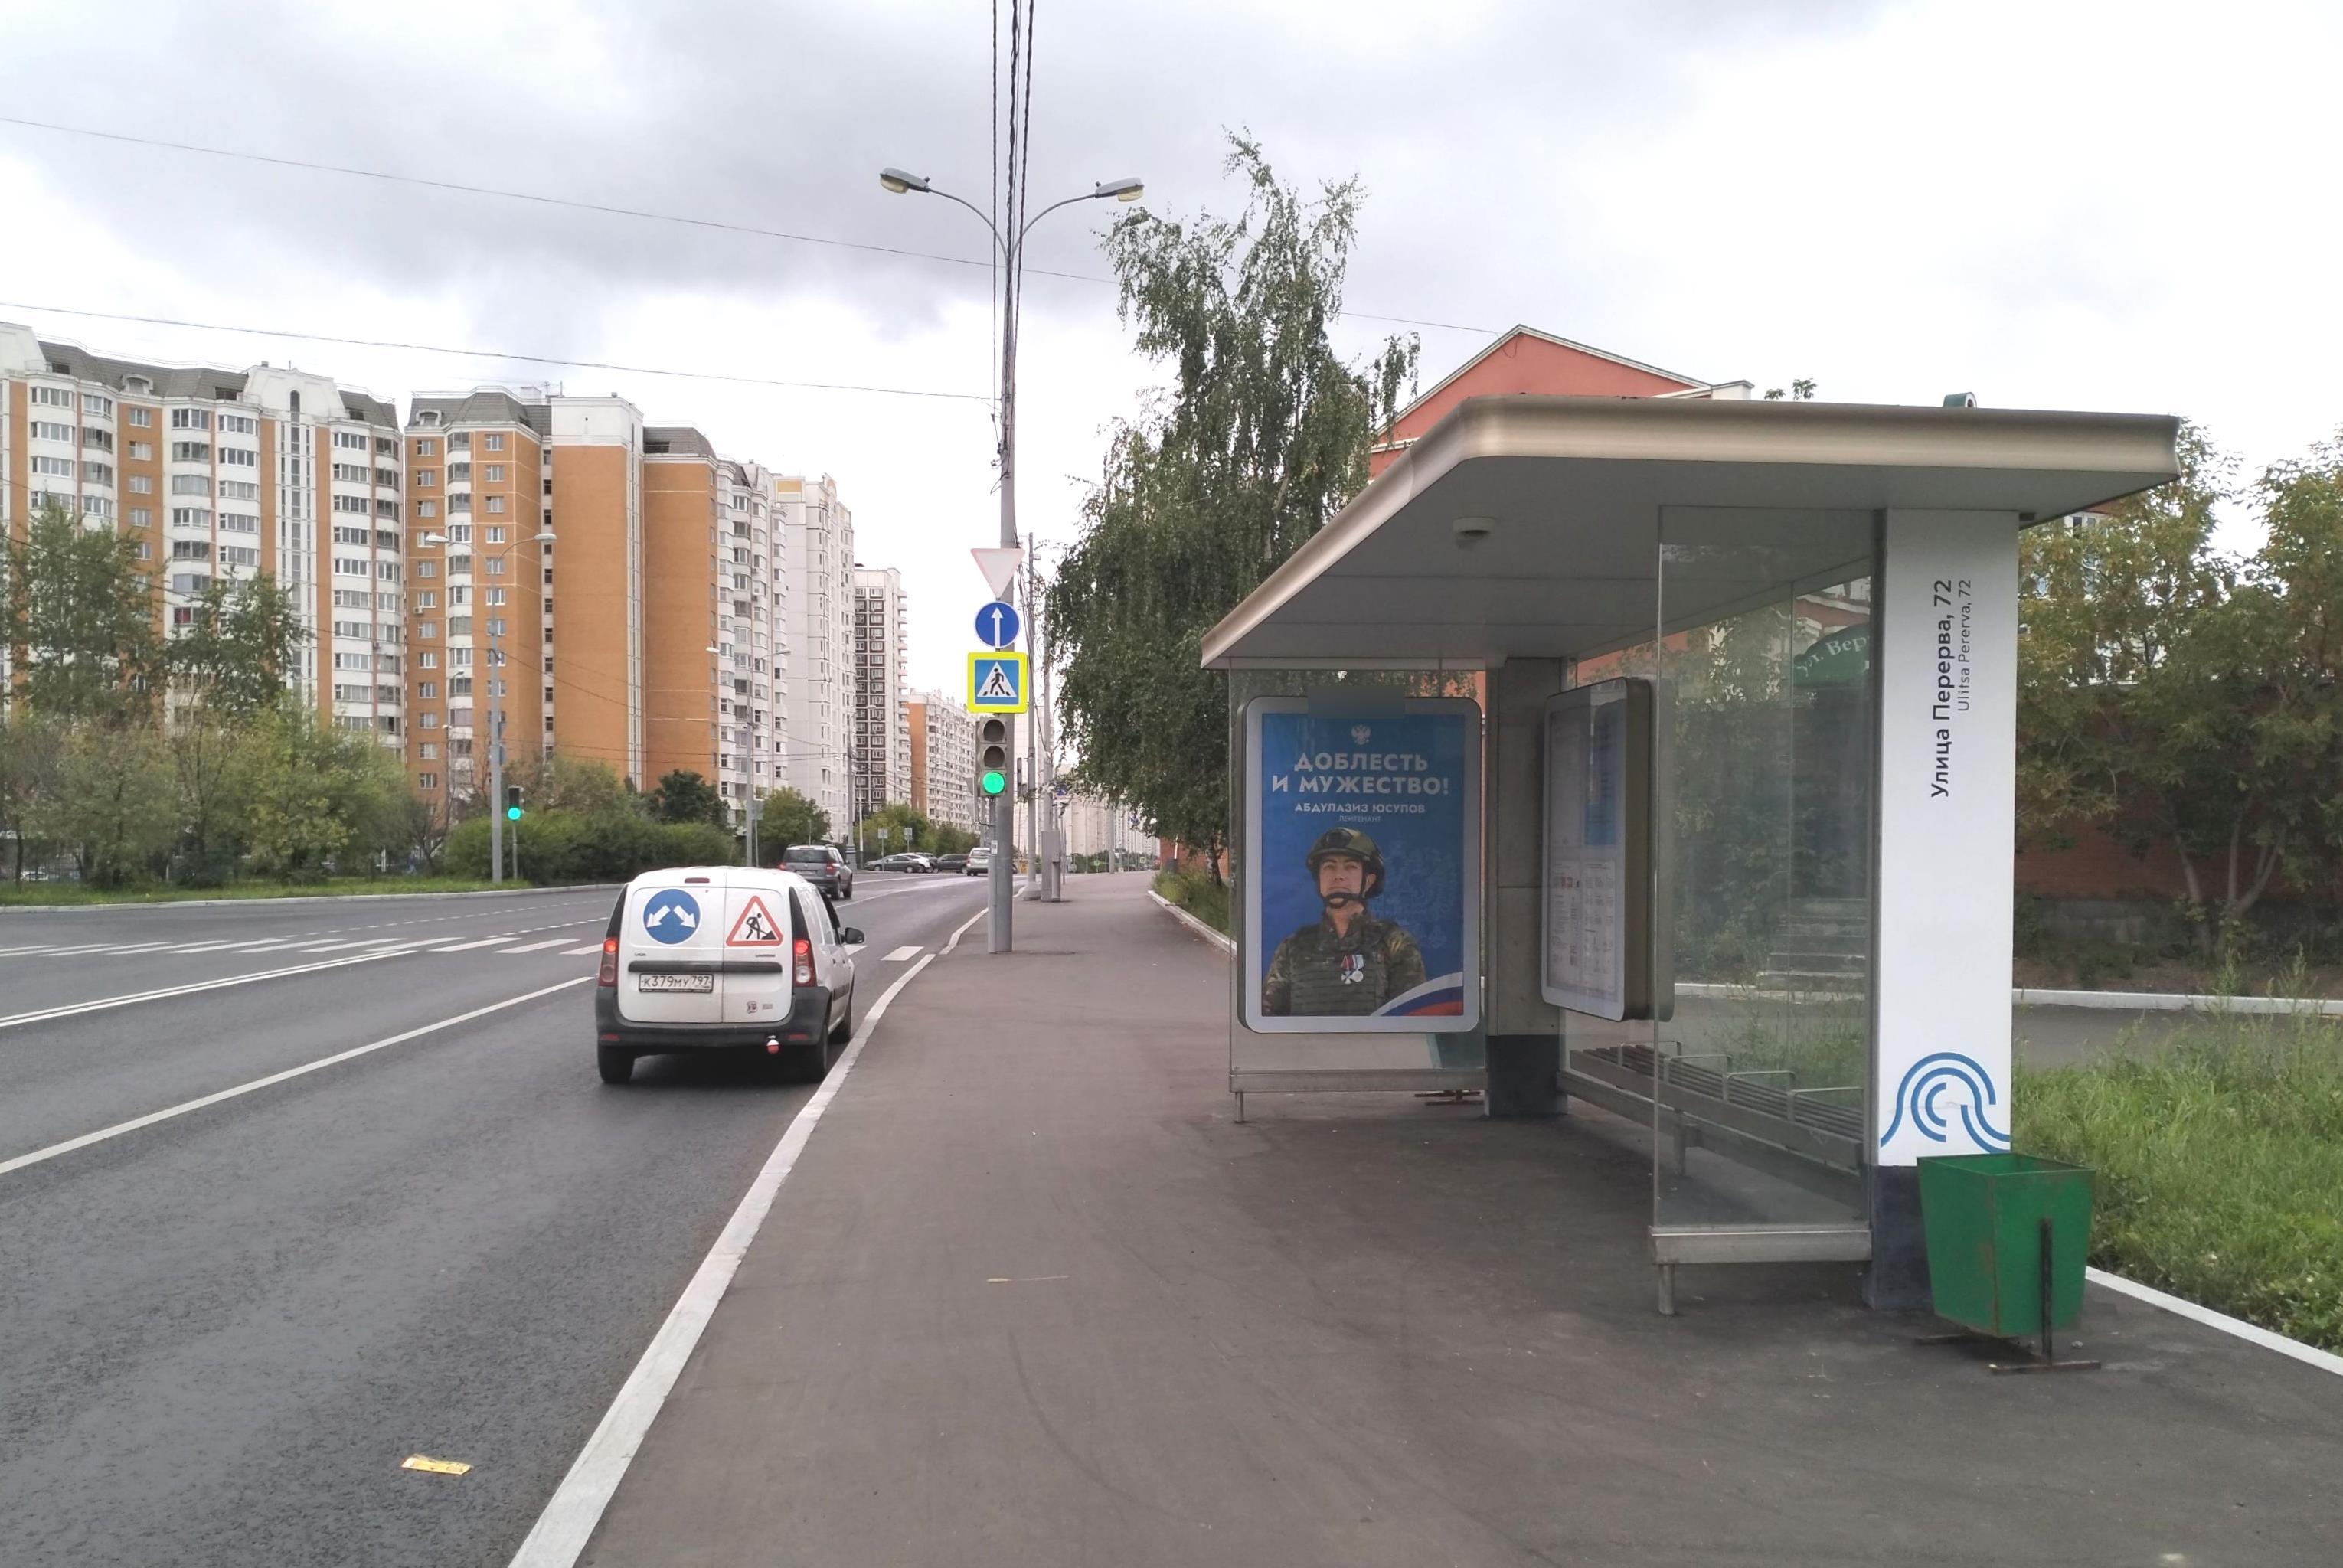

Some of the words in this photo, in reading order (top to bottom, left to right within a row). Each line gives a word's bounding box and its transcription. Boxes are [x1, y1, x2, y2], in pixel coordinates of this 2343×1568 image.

[1933, 580, 1952, 606] 72
[1958, 580, 1971, 598] 72
[1958, 603, 1972, 662] Pererva,
[1825, 635, 1870, 655] Вер
[1933, 614, 1955, 720] Перерва,
[1957, 668, 1970, 711] Ulitsa
[1294, 753, 1428, 772] ДОБЛЕСТЬ
[1930, 728, 1953, 797] Улица
[1273, 775, 1289, 792] И
[1299, 776, 1449, 795] МУЖЕСТВО!
[1294, 802, 1368, 813] АБДУЛАЗИЗ
[1372, 804, 1426, 814] ЮСУПОВ
